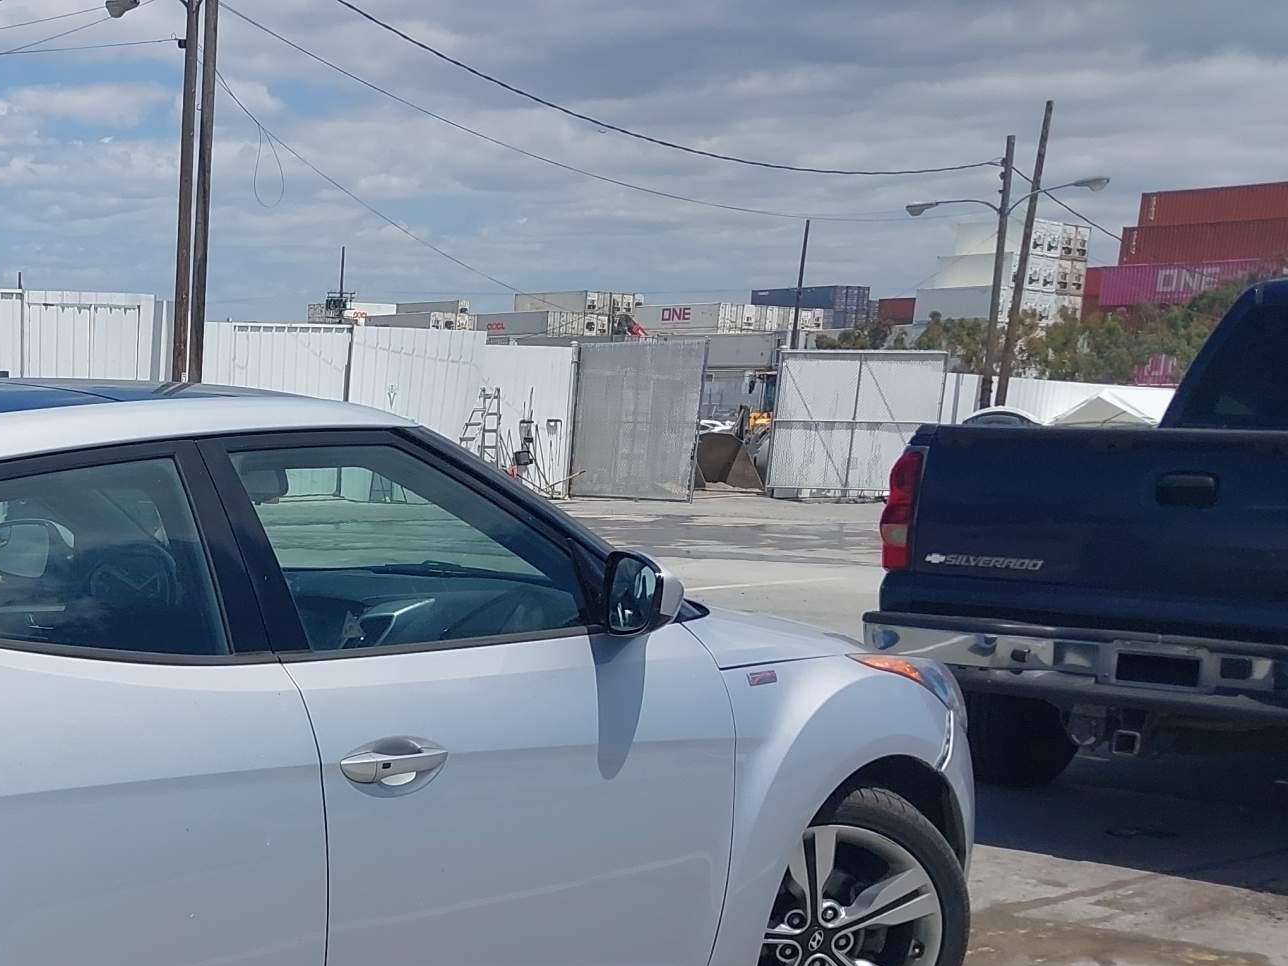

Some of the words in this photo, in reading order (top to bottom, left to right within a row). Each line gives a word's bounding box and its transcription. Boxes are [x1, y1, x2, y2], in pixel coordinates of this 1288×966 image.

[1157, 267, 1220, 292] ONE
[661, 307, 691, 322] ONE
[945, 554, 1044, 571] SILVERADO
